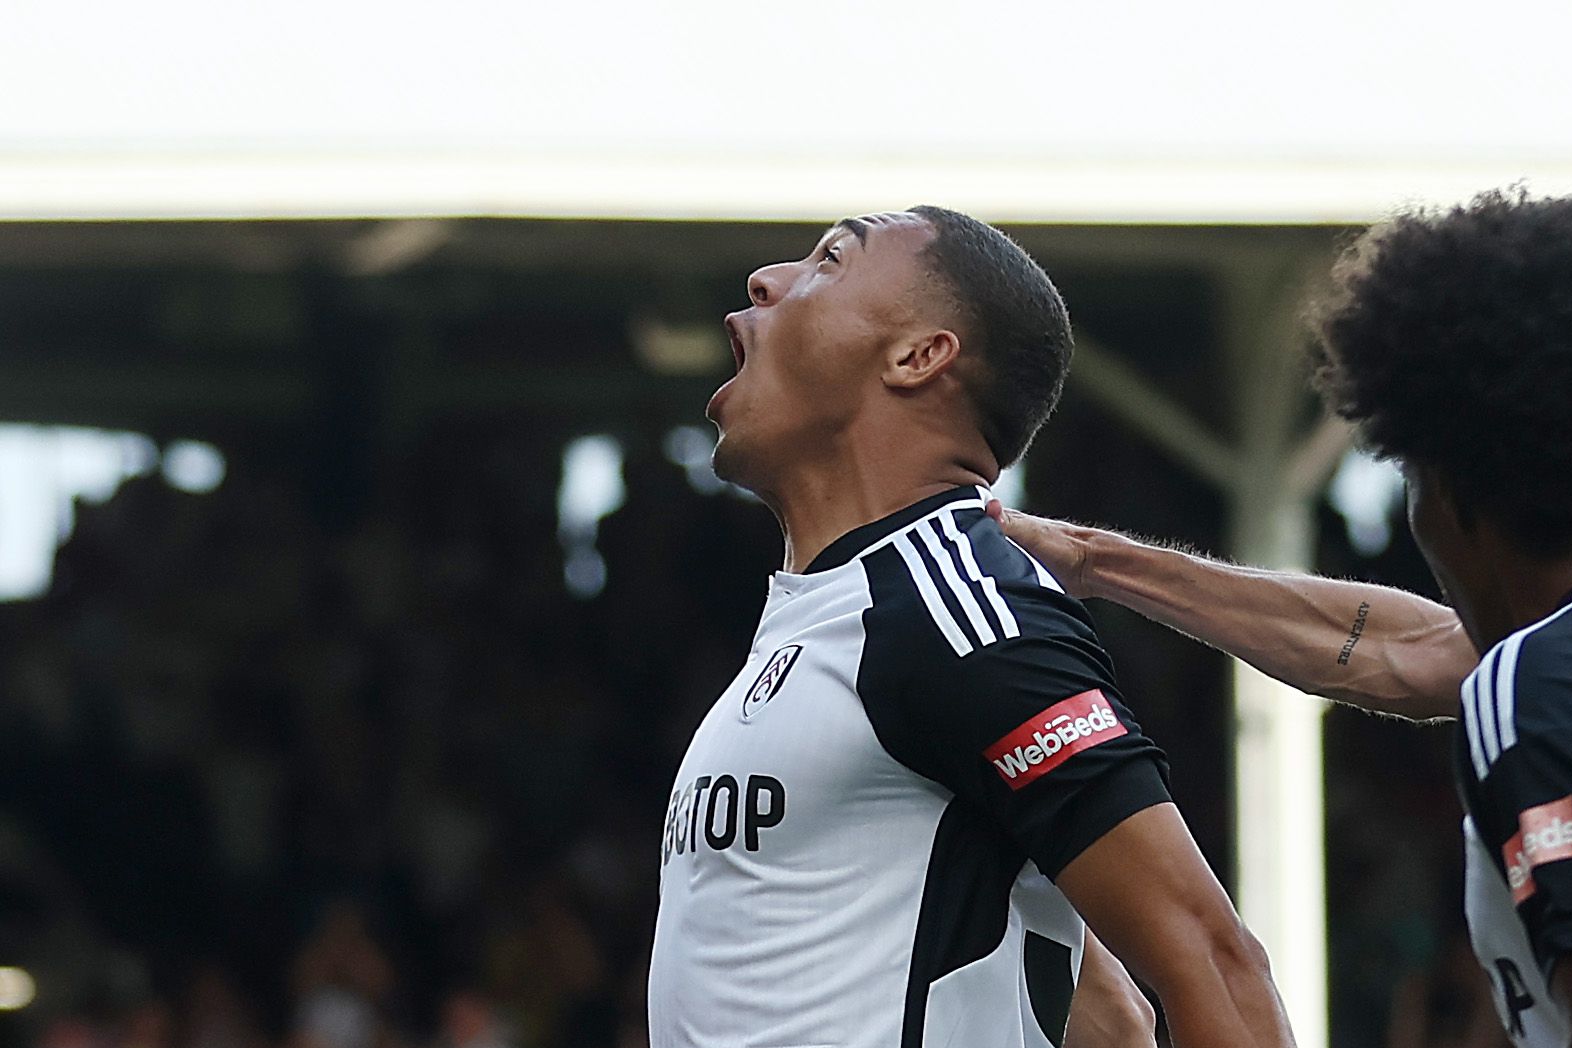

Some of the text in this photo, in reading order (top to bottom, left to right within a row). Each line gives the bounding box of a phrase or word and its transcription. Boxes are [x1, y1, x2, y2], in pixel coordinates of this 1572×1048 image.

[1338, 602, 1370, 665] ADVENTURE
[994, 704, 1118, 778] WebBeds
[663, 774, 786, 867] BOTOP
